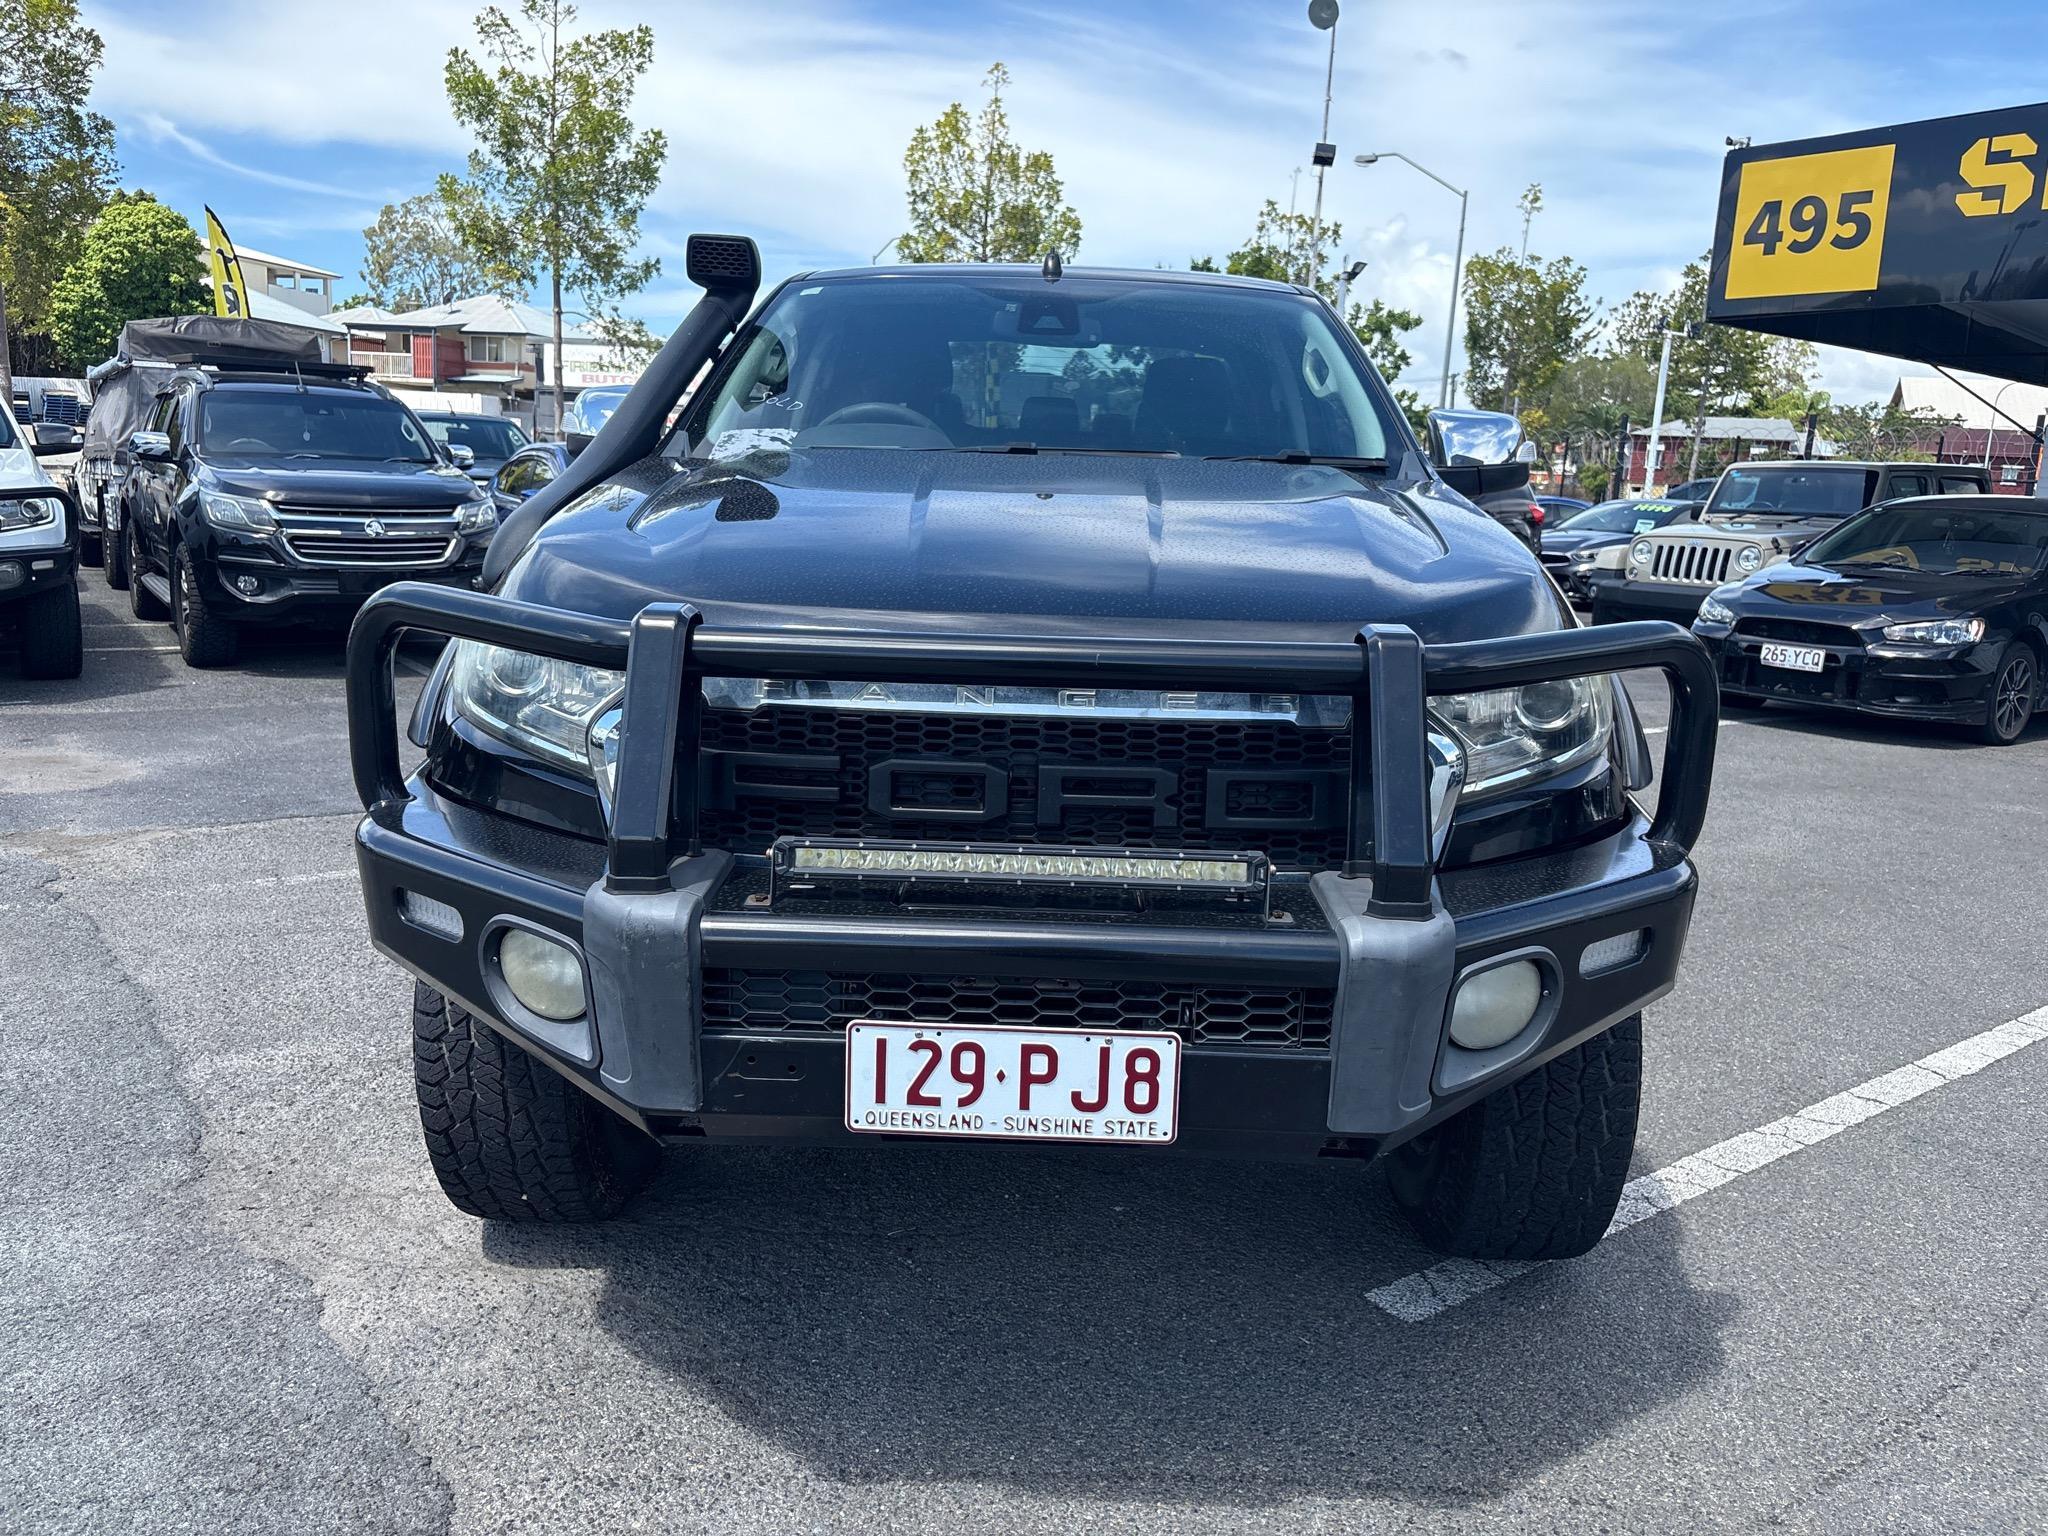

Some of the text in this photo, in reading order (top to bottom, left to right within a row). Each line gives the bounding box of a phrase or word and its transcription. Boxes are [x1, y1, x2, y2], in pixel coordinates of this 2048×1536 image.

[1955, 133, 2048, 217] S
[1743, 190, 1874, 256] 495
[582, 374, 637, 384] BUTC
[750, 391, 803, 411] SOLD
[754, 679, 1299, 713] RANGER
[699, 747, 1350, 829] FORD
[865, 1111, 983, 1130] QUEENSLAND
[1004, 1116, 1093, 1134] SUNSHINE
[1105, 1119, 1158, 1136] STATE
